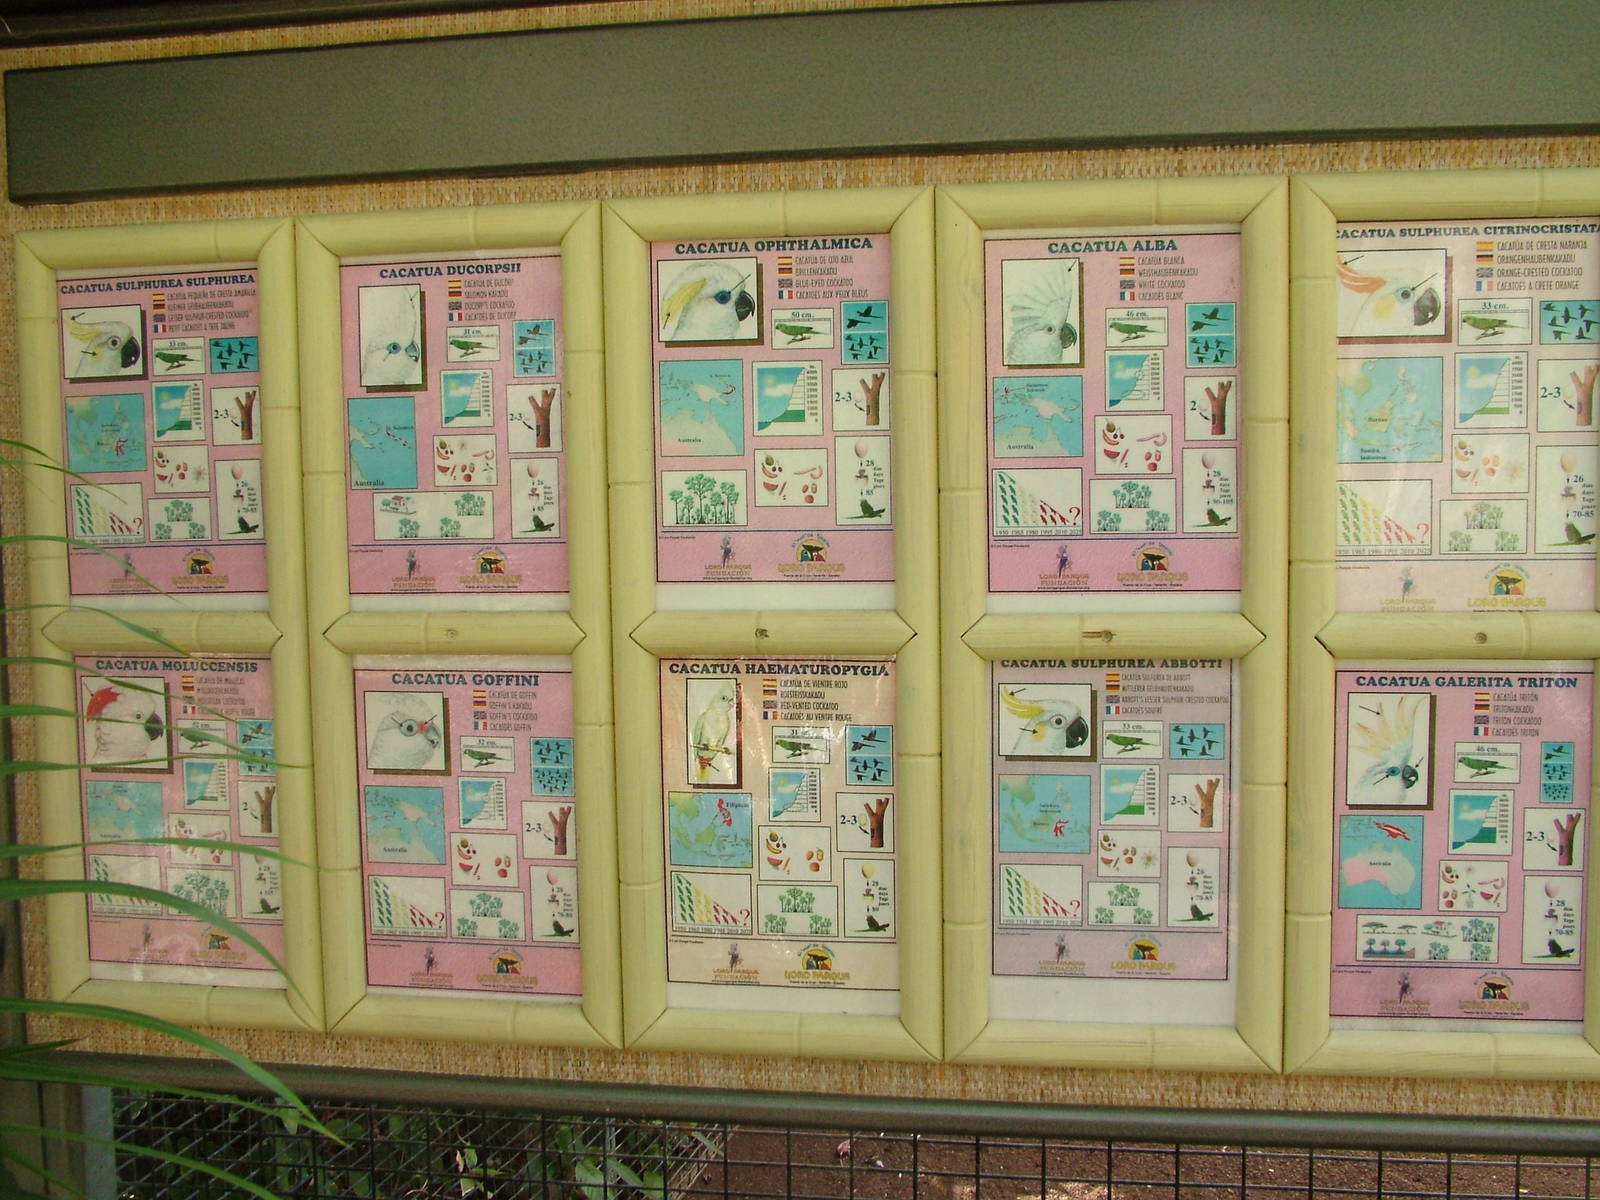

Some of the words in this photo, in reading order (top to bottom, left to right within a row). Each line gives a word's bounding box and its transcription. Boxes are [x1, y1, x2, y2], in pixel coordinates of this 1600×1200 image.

[1400, 227, 1479, 237] SULPHUREA
[675, 242, 750, 254] CACATUA
[754, 237, 873, 251] OPHTHALMICA
[1048, 241, 1128, 254] CACATUA
[1133, 239, 1178, 251] ALBA
[1526, 241, 1534, 250] DE
[1536, 241, 1558, 250] CRESTA
[1560, 240, 1587, 249] NARANJA
[1497, 254, 1576, 264] ORANGENHAUBENKAKADU
[380, 267, 443, 278] CACATUA
[447, 263, 521, 275] DUCORPSII
[1497, 268, 1549, 277] ORANGE-CRESTED
[1551, 267, 1582, 276] COCKATOO
[61, 283, 113, 294] CACATUA
[116, 279, 184, 291] SULPHUREA
[186, 275, 255, 287] SULPHUREA
[1555, 280, 1579, 289] ORANGE
[835, 392, 852, 402] 2-3
[1541, 387, 1561, 398] 2-3
[1191, 401, 1197, 411] 2
[214, 409, 229, 419] 2-3
[509, 413, 523, 422] 2-3
[1573, 474, 1584, 483] 26
[1573, 510, 1594, 518] 70-85
[96, 660, 159, 671] CACATUA
[162, 661, 258, 672] MOLUCCENSIS
[1001, 659, 1067, 668] CACATUA
[1071, 659, 1154, 668] SULPHUREA
[1160, 659, 1223, 669] ABBOTTI
[669, 663, 740, 674] CACATUA
[746, 664, 889, 676] HAEMATUROPYGIA
[392, 673, 467, 685] CACATUA
[472, 674, 539, 686] GOFFINI
[812, 680, 833, 688] VIENTRE
[1356, 677, 1431, 686] CACATUA
[1435, 677, 1513, 688] GALERITA
[1518, 677, 1578, 688] TRITON
[781, 701, 811, 710] RED-VENTED
[813, 702, 839, 710] COCKATOO
[1170, 796, 1187, 805] 2-3
[840, 815, 857, 825] 2-3
[525, 823, 542, 832] 2-3
[1526, 832, 1545, 842] 2-3
